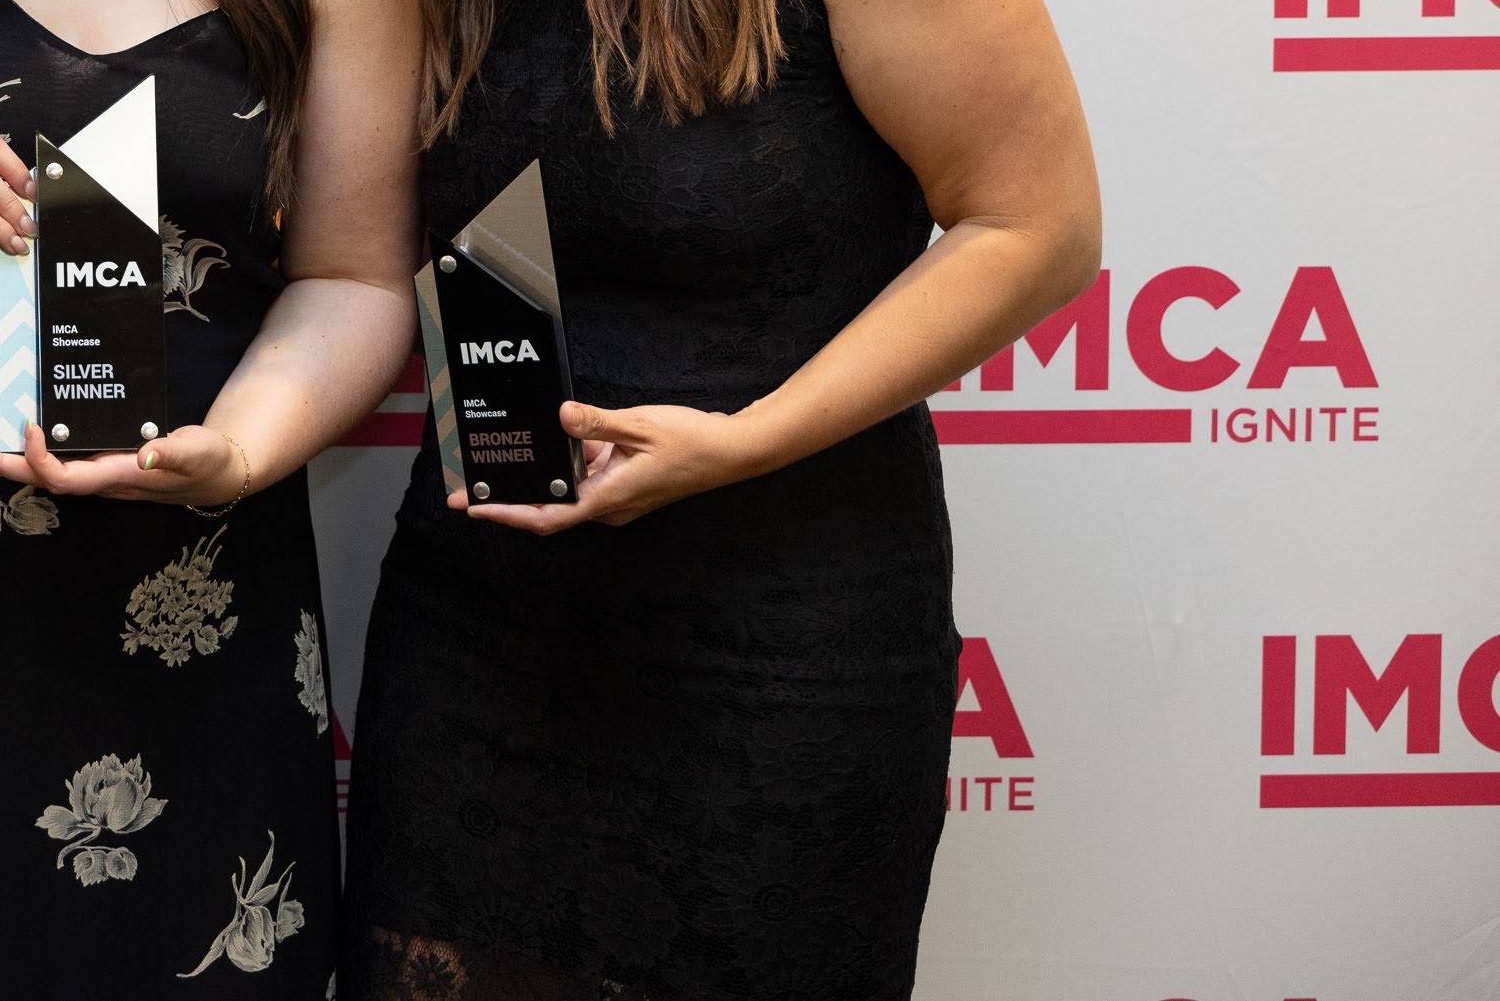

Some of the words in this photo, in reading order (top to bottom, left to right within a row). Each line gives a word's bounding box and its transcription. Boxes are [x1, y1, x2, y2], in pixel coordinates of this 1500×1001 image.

[55, 260, 147, 288] IMCA
[52, 324, 78, 335] IMCA
[940, 266, 1379, 392] MCA
[52, 336, 101, 348] Showcase
[459, 338, 540, 365] IMCA
[53, 363, 114, 380] SILVER
[53, 383, 126, 400] WINNER
[463, 398, 487, 409] IMCA
[465, 408, 507, 419] Showcase
[1211, 407, 1379, 443] IGNITE
[468, 430, 533, 448] BRONZE
[471, 447, 535, 464] WINNER
[1260, 634, 1500, 756] IM
[945, 777, 1035, 811] ITE
